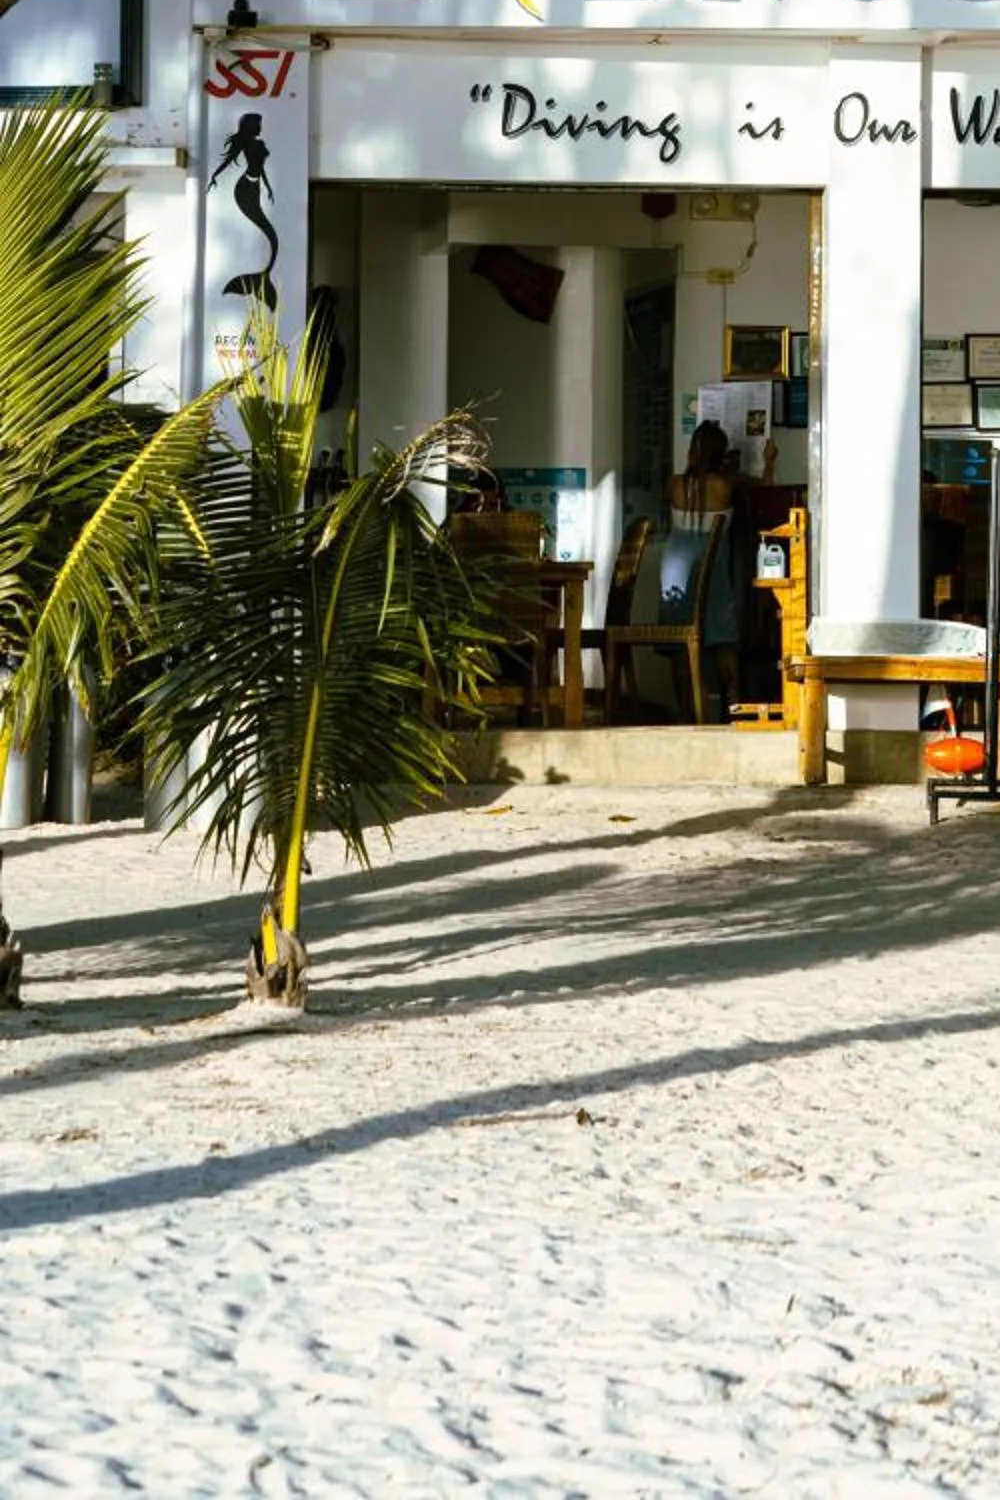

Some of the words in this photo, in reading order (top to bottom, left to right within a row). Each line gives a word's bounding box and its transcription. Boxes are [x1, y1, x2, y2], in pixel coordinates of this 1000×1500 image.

[204, 50, 295, 98] SSI
[739, 102, 785, 141] is
[834, 91, 918, 146] Our
